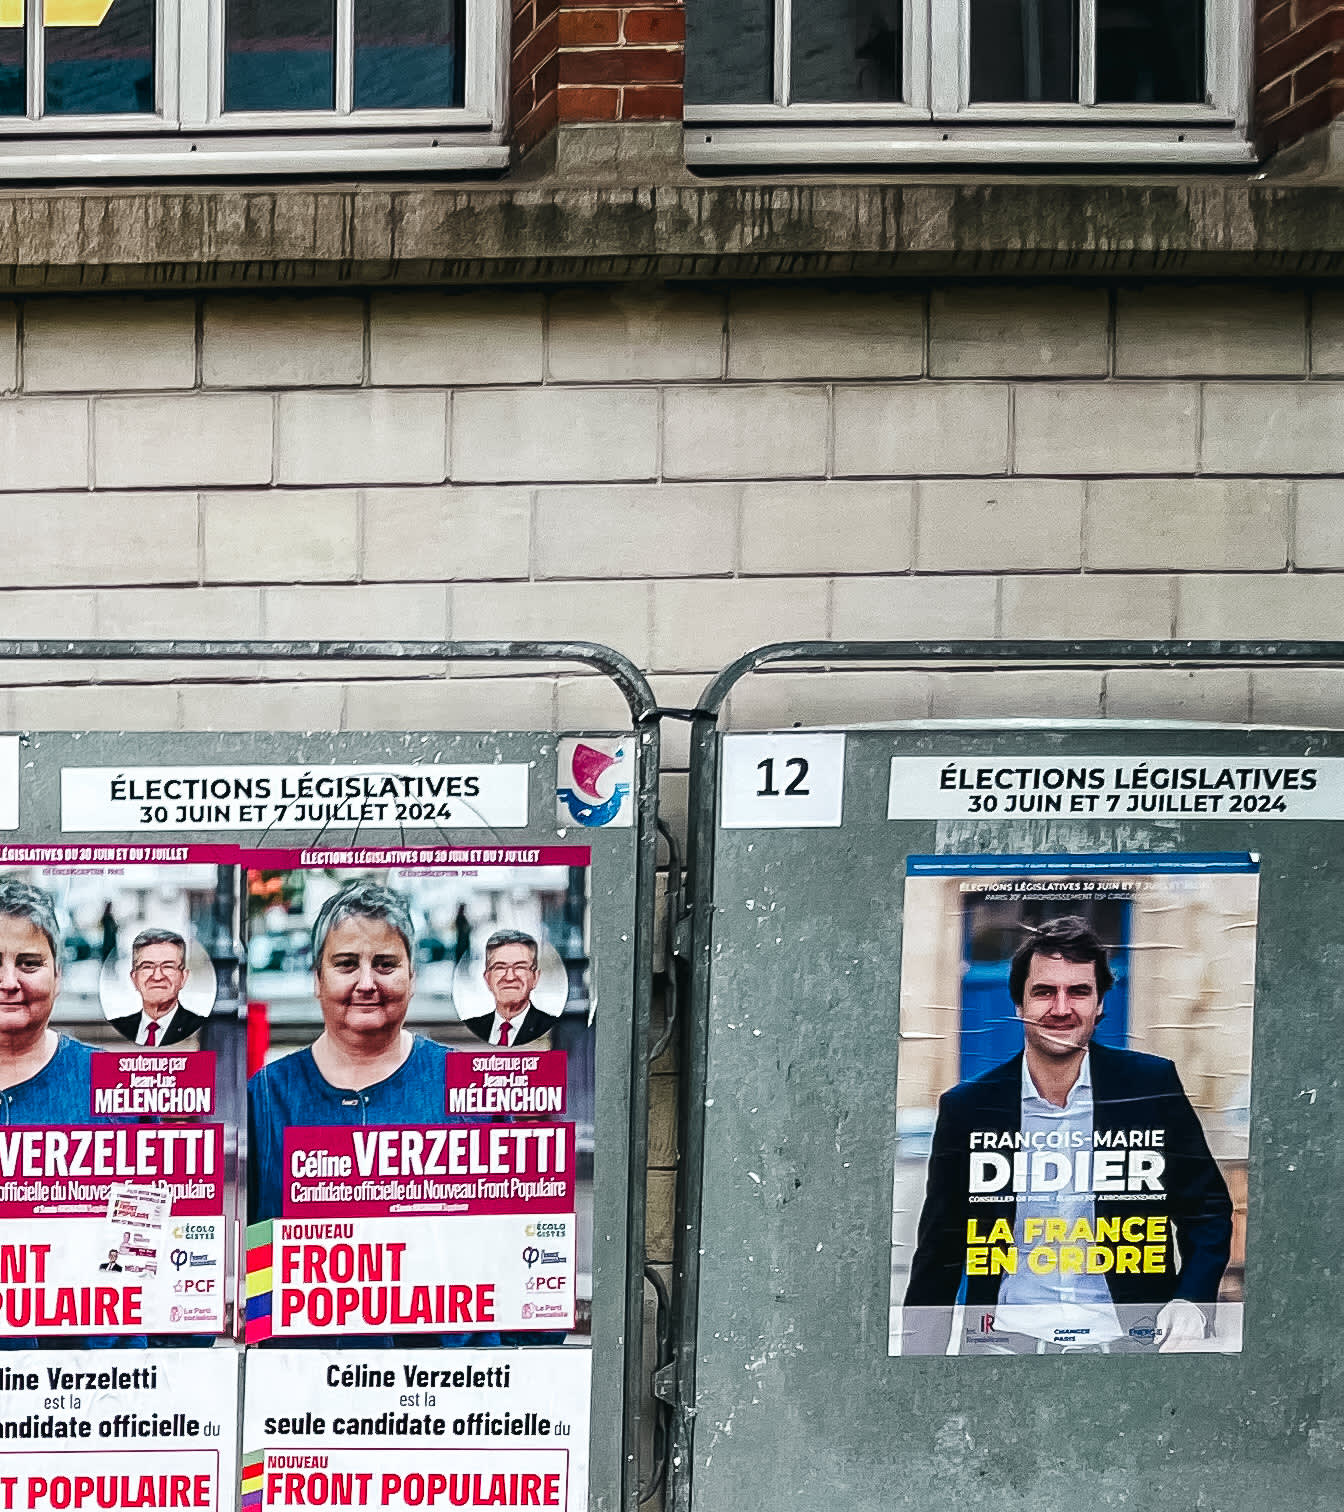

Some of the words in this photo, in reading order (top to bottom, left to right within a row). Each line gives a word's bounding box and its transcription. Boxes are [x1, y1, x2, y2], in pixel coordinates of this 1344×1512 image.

[110, 774, 271, 801] ÉLECTIONS
[281, 771, 480, 798] LÉGISLATIVES
[755, 757, 811, 797] 12
[939, 763, 1106, 790] ÉLECTIONS
[1114, 762, 1318, 790] LÉGISLATIVES
[140, 806, 168, 823] 30
[175, 805, 230, 823] JUIN
[239, 805, 267, 822] ET
[275, 804, 288, 821] 7
[294, 804, 386, 821] JUILLET
[395, 803, 452, 820] 2024
[968, 795, 999, 813] 30
[1005, 795, 1061, 813] JUIN
[1070, 795, 1099, 812] ET
[1106, 795, 1120, 813] 7
[1126, 795, 1224, 813] JUILLET
[1228, 794, 1287, 813] 2024
[151, 847, 189, 861] JUILLET
[300, 850, 354, 865] ÉLECTIONS
[354, 850, 417, 864] LÉGISLATIVES
[1015, 882, 1080, 892] LÉGISLATIVES
[118, 1056, 167, 1072] soutenue
[473, 1056, 520, 1072] soutenue
[131, 1073, 176, 1088] Jean-Luc
[483, 1072, 529, 1087] Jean-Luc
[94, 1082, 211, 1113] MÉLENCHON
[449, 1082, 563, 1113] MÉLENCHON
[969, 1129, 1165, 1152] FRANÇOIS-MARIE
[290, 1149, 353, 1179] Céline
[352, 1128, 567, 1177] VERZELETTI
[968, 1150, 1166, 1194] DIDIER
[51, 1180, 68, 1201] du
[290, 1181, 353, 1203] Candidate
[353, 1180, 406, 1202] officielle
[406, 1180, 422, 1201] du
[422, 1179, 476, 1200] Nouveau
[476, 1178, 510, 1199] Front
[510, 1177, 567, 1201] Populaire
[281, 1223, 354, 1240] NOUVEAU
[966, 1219, 1014, 1245] LA
[1023, 1215, 1168, 1244] FRANCE
[281, 1243, 407, 1284] FRONT
[965, 1246, 1018, 1276] EN
[1027, 1245, 1167, 1276] ORDRE
[184, 1279, 216, 1293] PCF
[536, 1277, 567, 1290] PCF
[281, 1284, 496, 1327] POPULAIRE
[47, 1365, 158, 1390] Verzeletti
[326, 1365, 396, 1388] Céline
[403, 1364, 511, 1388] Verzeletti
[43, 1394, 67, 1410] est
[69, 1394, 81, 1410] la
[399, 1392, 420, 1407] est
[424, 1391, 436, 1407] la
[98, 1413, 200, 1438] officielle
[203, 1421, 221, 1437] du
[263, 1412, 326, 1436] seule
[332, 1412, 446, 1436] candidate
[452, 1412, 551, 1436] officielle
[554, 1420, 571, 1436] du
[267, 1455, 329, 1469] NOUVEAU
[27, 1474, 211, 1510] POPULAIRE
[266, 1473, 373, 1506] FRONT
[381, 1473, 561, 1506] POPULAIRE
